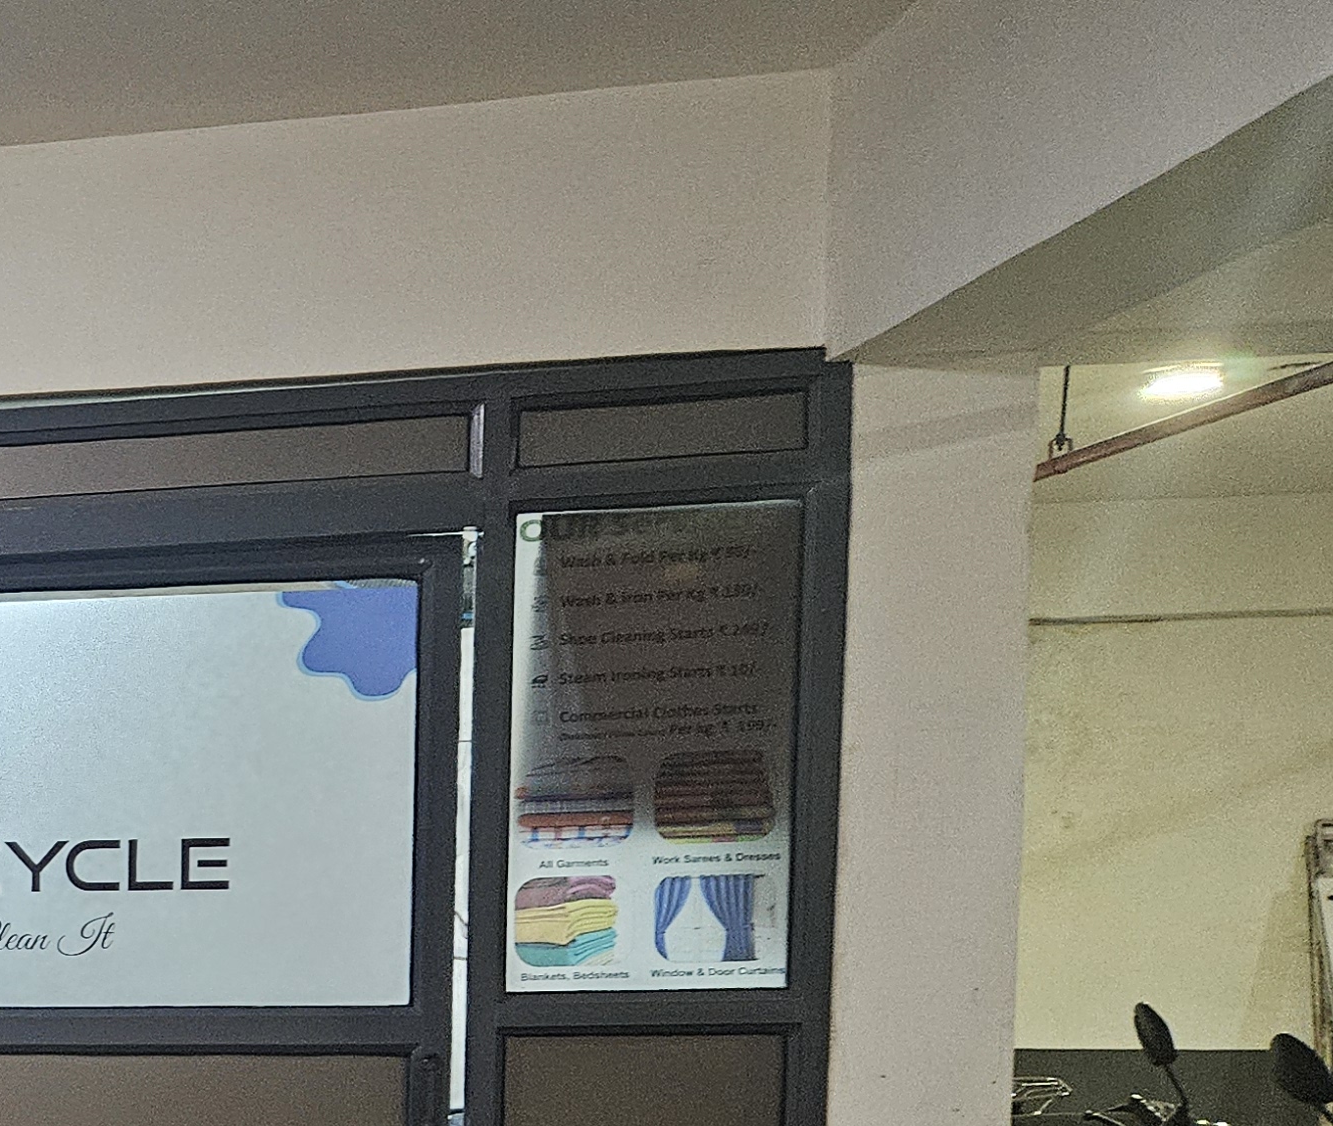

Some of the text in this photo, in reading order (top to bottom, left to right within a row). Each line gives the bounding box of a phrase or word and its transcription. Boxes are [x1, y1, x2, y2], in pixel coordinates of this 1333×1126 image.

[560, 594, 600, 607] Wash
[605, 592, 616, 604] &
[559, 633, 596, 646] Shoe
[601, 630, 665, 645] Cleaning
[670, 626, 713, 639] Starts
[559, 673, 606, 686] Steam
[612, 671, 665, 684] Ironing
[669, 666, 712, 679] Starts
[560, 709, 648, 723] Commercial
[653, 705, 710, 719] Clothes
[539, 859, 609, 868] All Garments
[652, 855, 680, 864] Work
[725, 853, 733, 862] &
[735, 852, 781, 862] Dresses
[58, 912, 116, 959] It
[573, 970, 630, 980] Bedsheets
[650, 966, 785, 978] Window & Door Curtains
